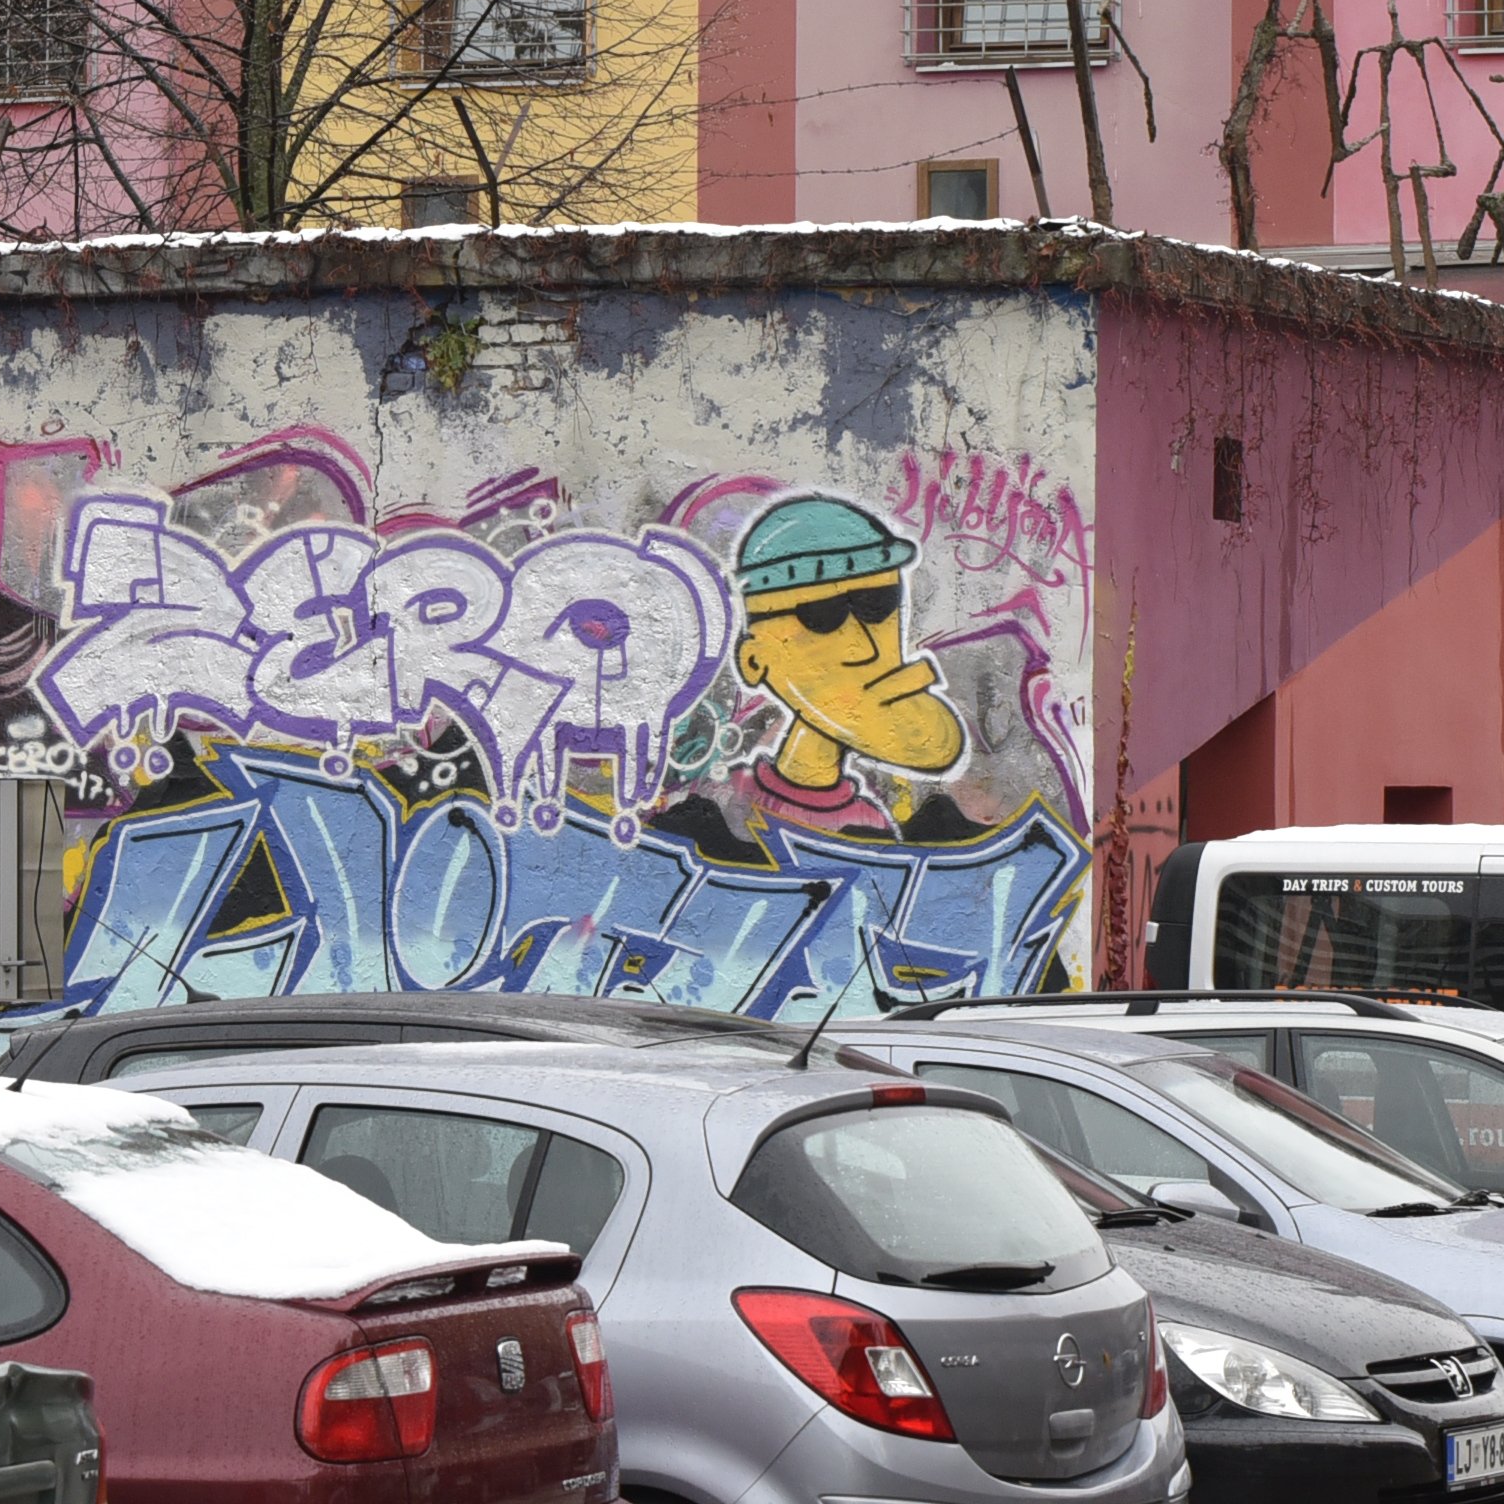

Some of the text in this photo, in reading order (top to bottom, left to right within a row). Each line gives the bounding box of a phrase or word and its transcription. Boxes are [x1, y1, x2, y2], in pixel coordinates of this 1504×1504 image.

[1283, 879, 1464, 893] DAY TRIPS & CUSTOM TOURS
[1456, 1439, 1472, 1475] LJ
